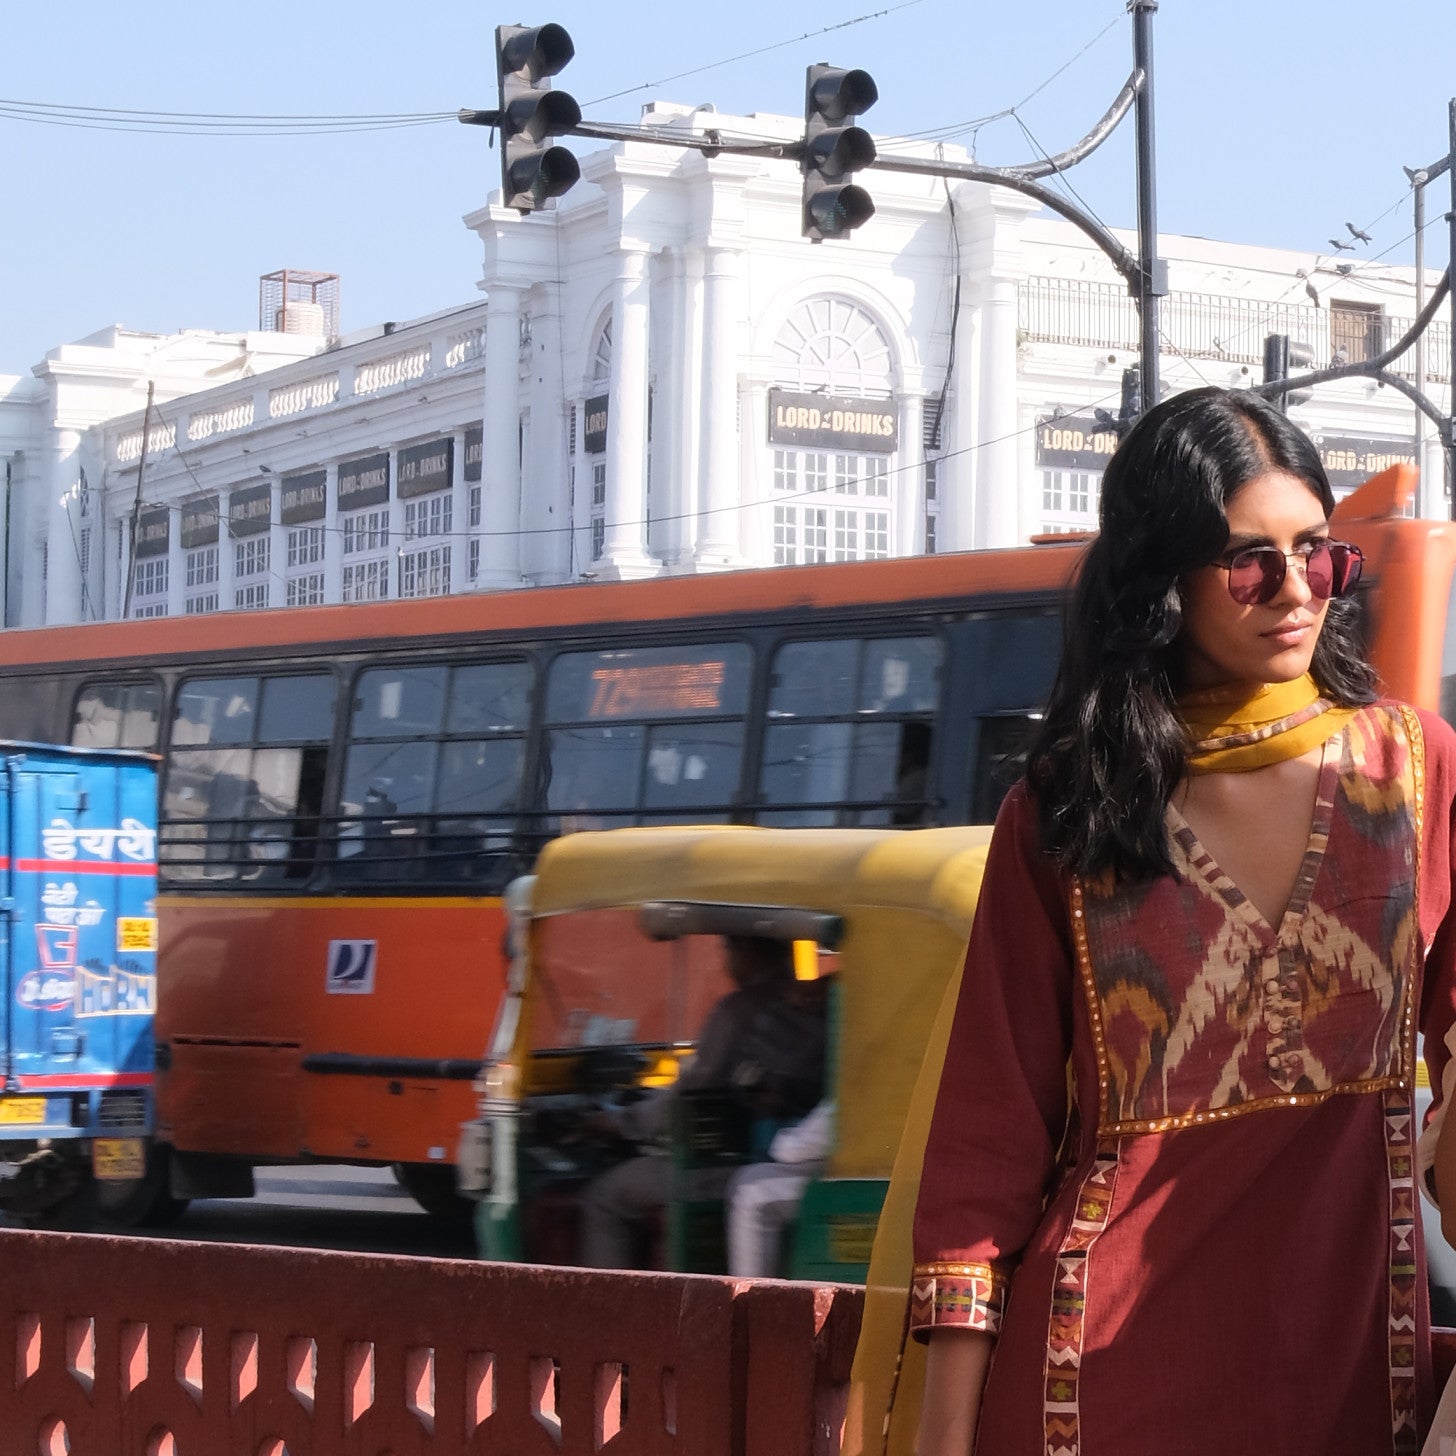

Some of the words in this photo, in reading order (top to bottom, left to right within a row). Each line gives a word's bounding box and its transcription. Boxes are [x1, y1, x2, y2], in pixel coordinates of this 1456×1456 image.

[776, 405, 820, 430] LORD
[832, 410, 894, 436] DRINKS
[1043, 428, 1084, 452] LORD
